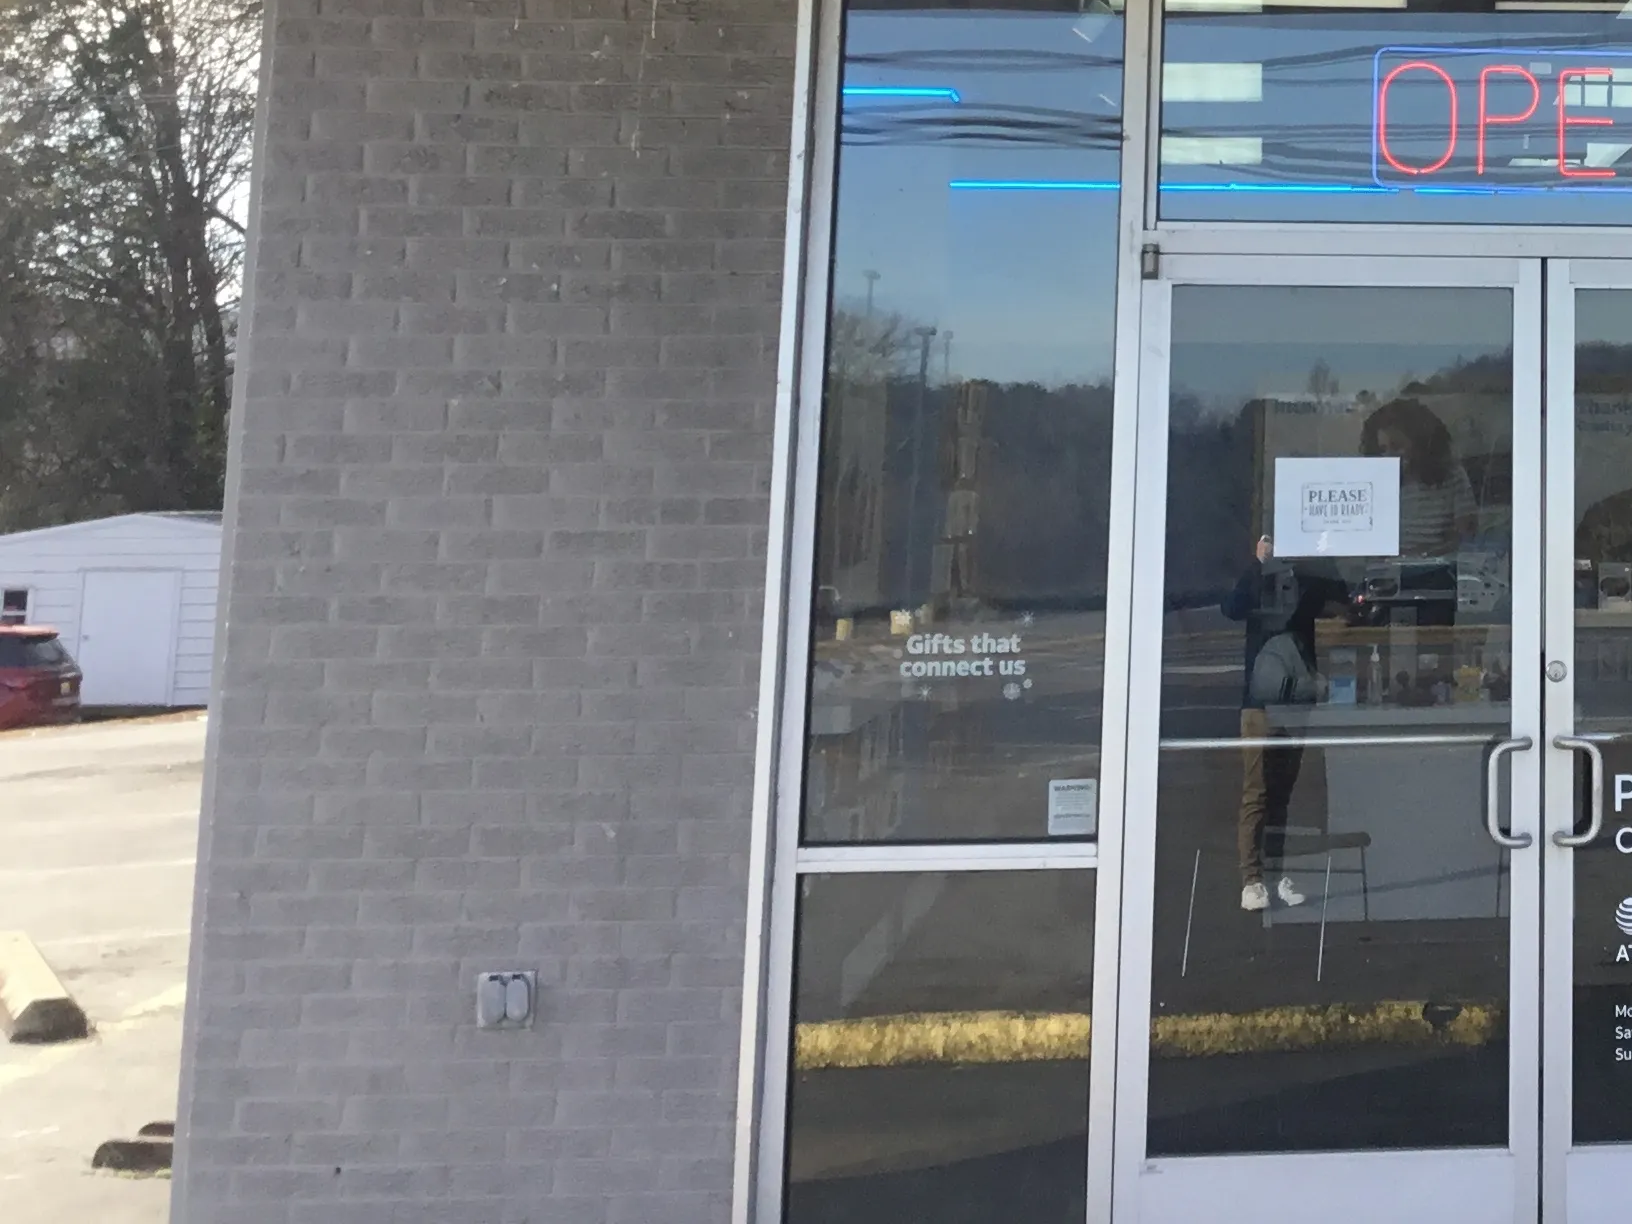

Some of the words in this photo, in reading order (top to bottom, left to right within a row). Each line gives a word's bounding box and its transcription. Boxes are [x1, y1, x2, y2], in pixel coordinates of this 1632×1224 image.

[1308, 489, 1367, 503] PLEASE
[906, 633, 966, 655] Gifts
[970, 632, 1022, 654] that
[900, 657, 993, 677] connect
[999, 659, 1026, 676] us
